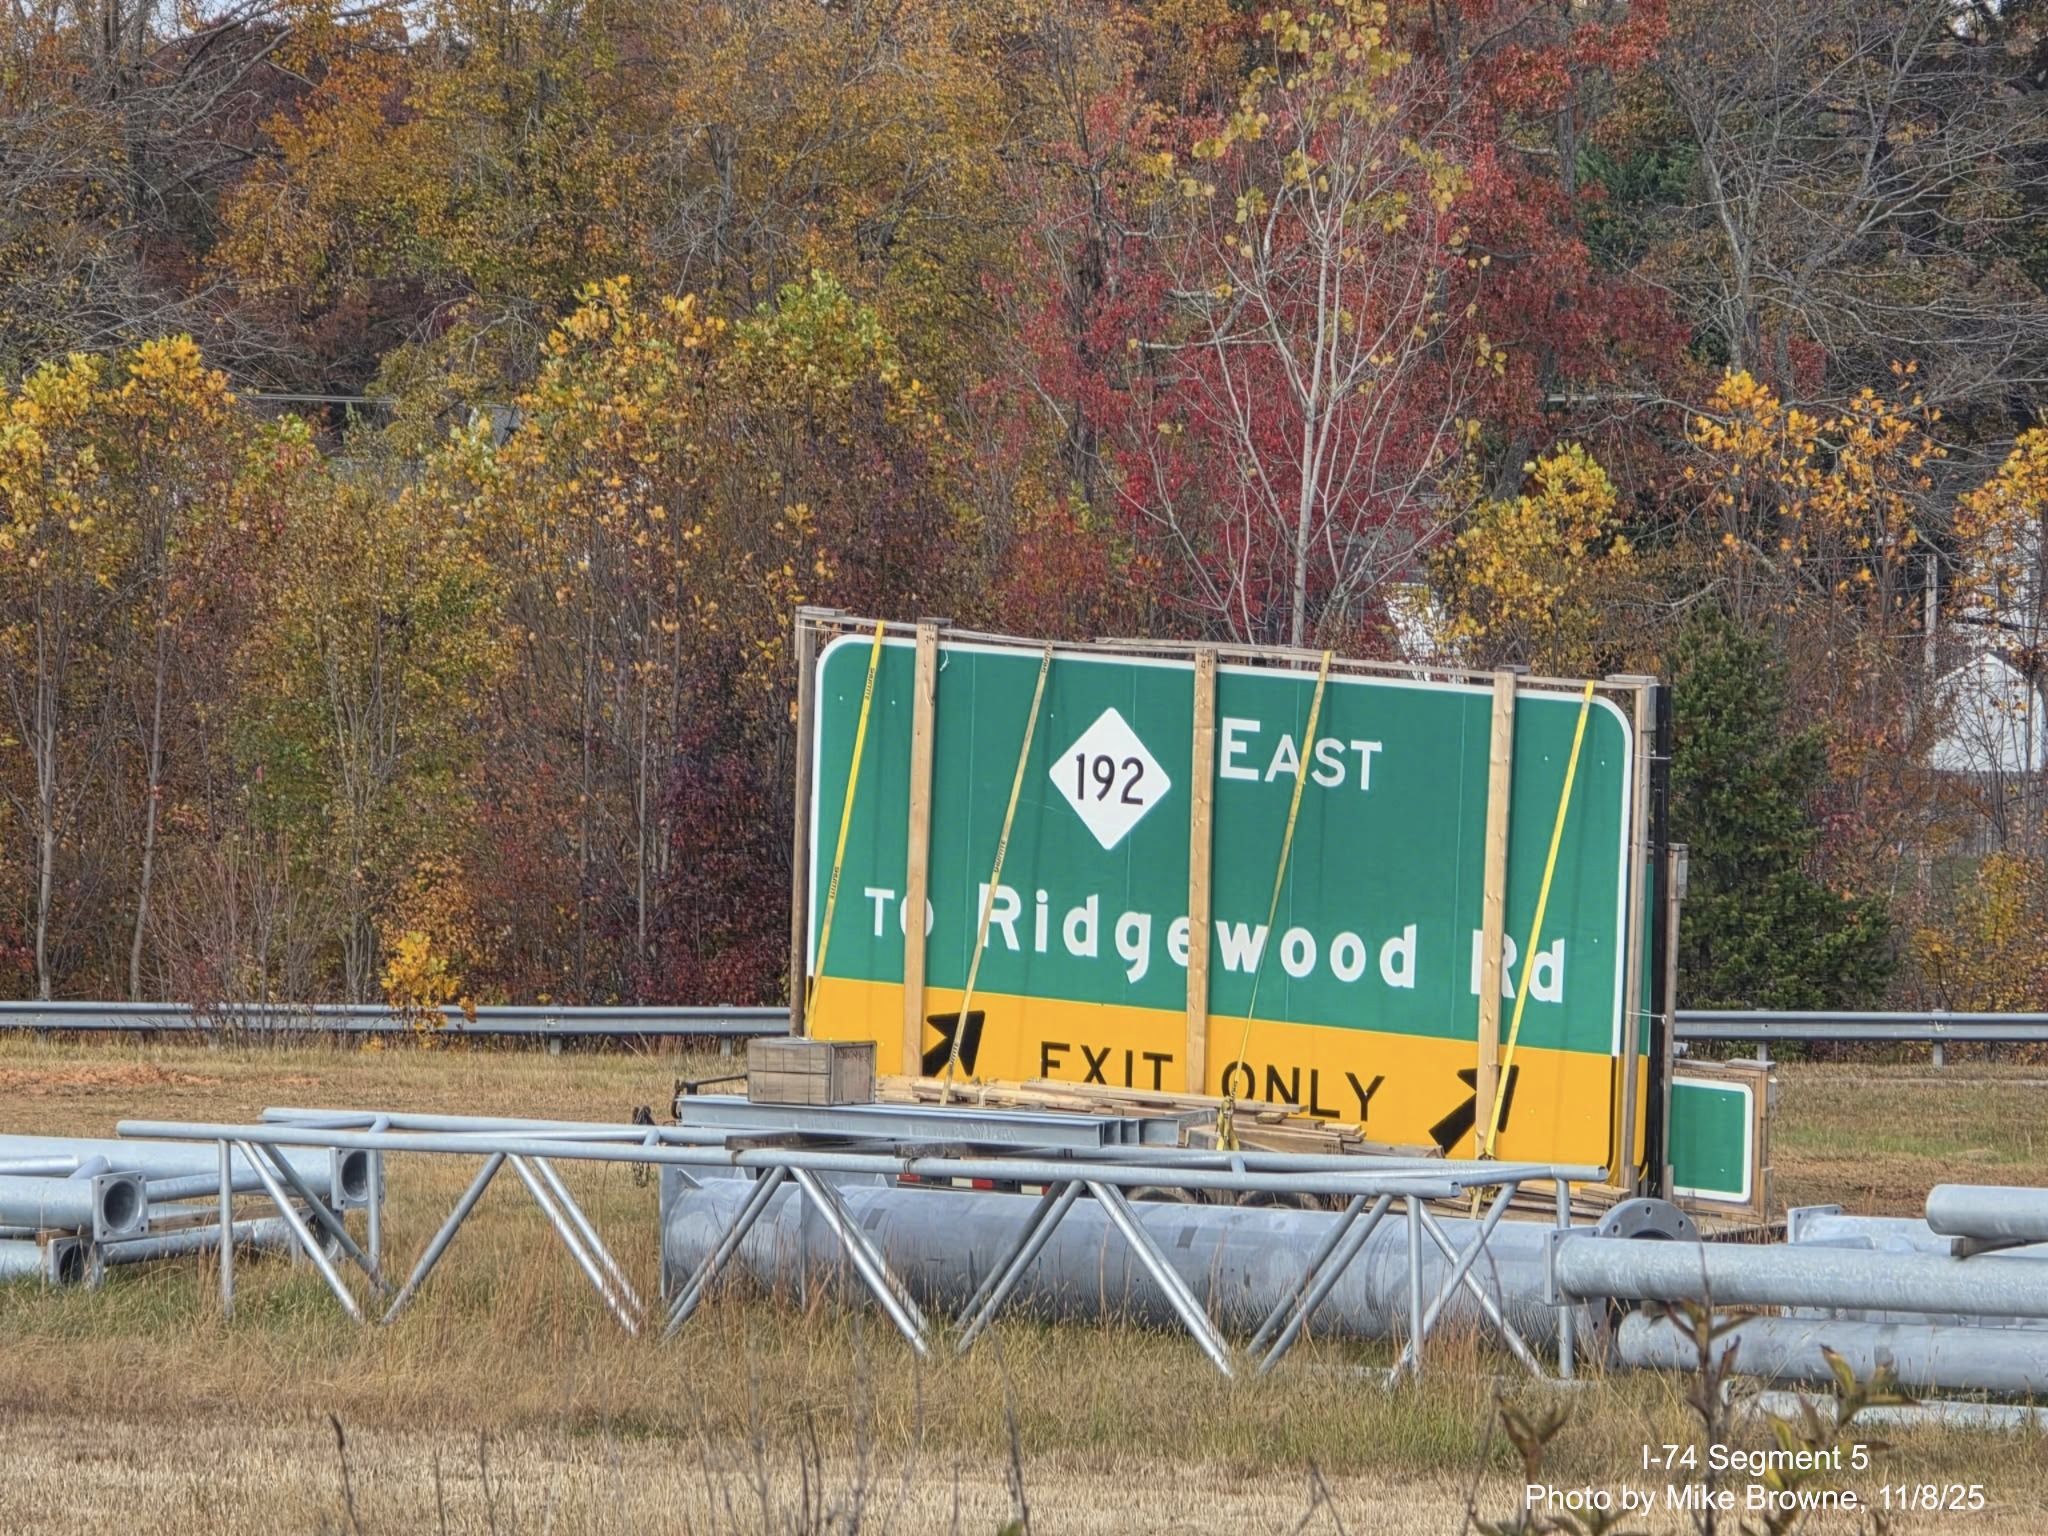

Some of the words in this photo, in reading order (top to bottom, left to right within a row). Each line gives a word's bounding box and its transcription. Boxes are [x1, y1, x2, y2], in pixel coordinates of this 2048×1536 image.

[1075, 752, 1144, 806] 192
[1219, 716, 1383, 791] EAST
[977, 882, 1418, 989] Ridgewood
[1470, 928, 1565, 1004] Rd
[1221, 1060, 1386, 1122] ONLY
